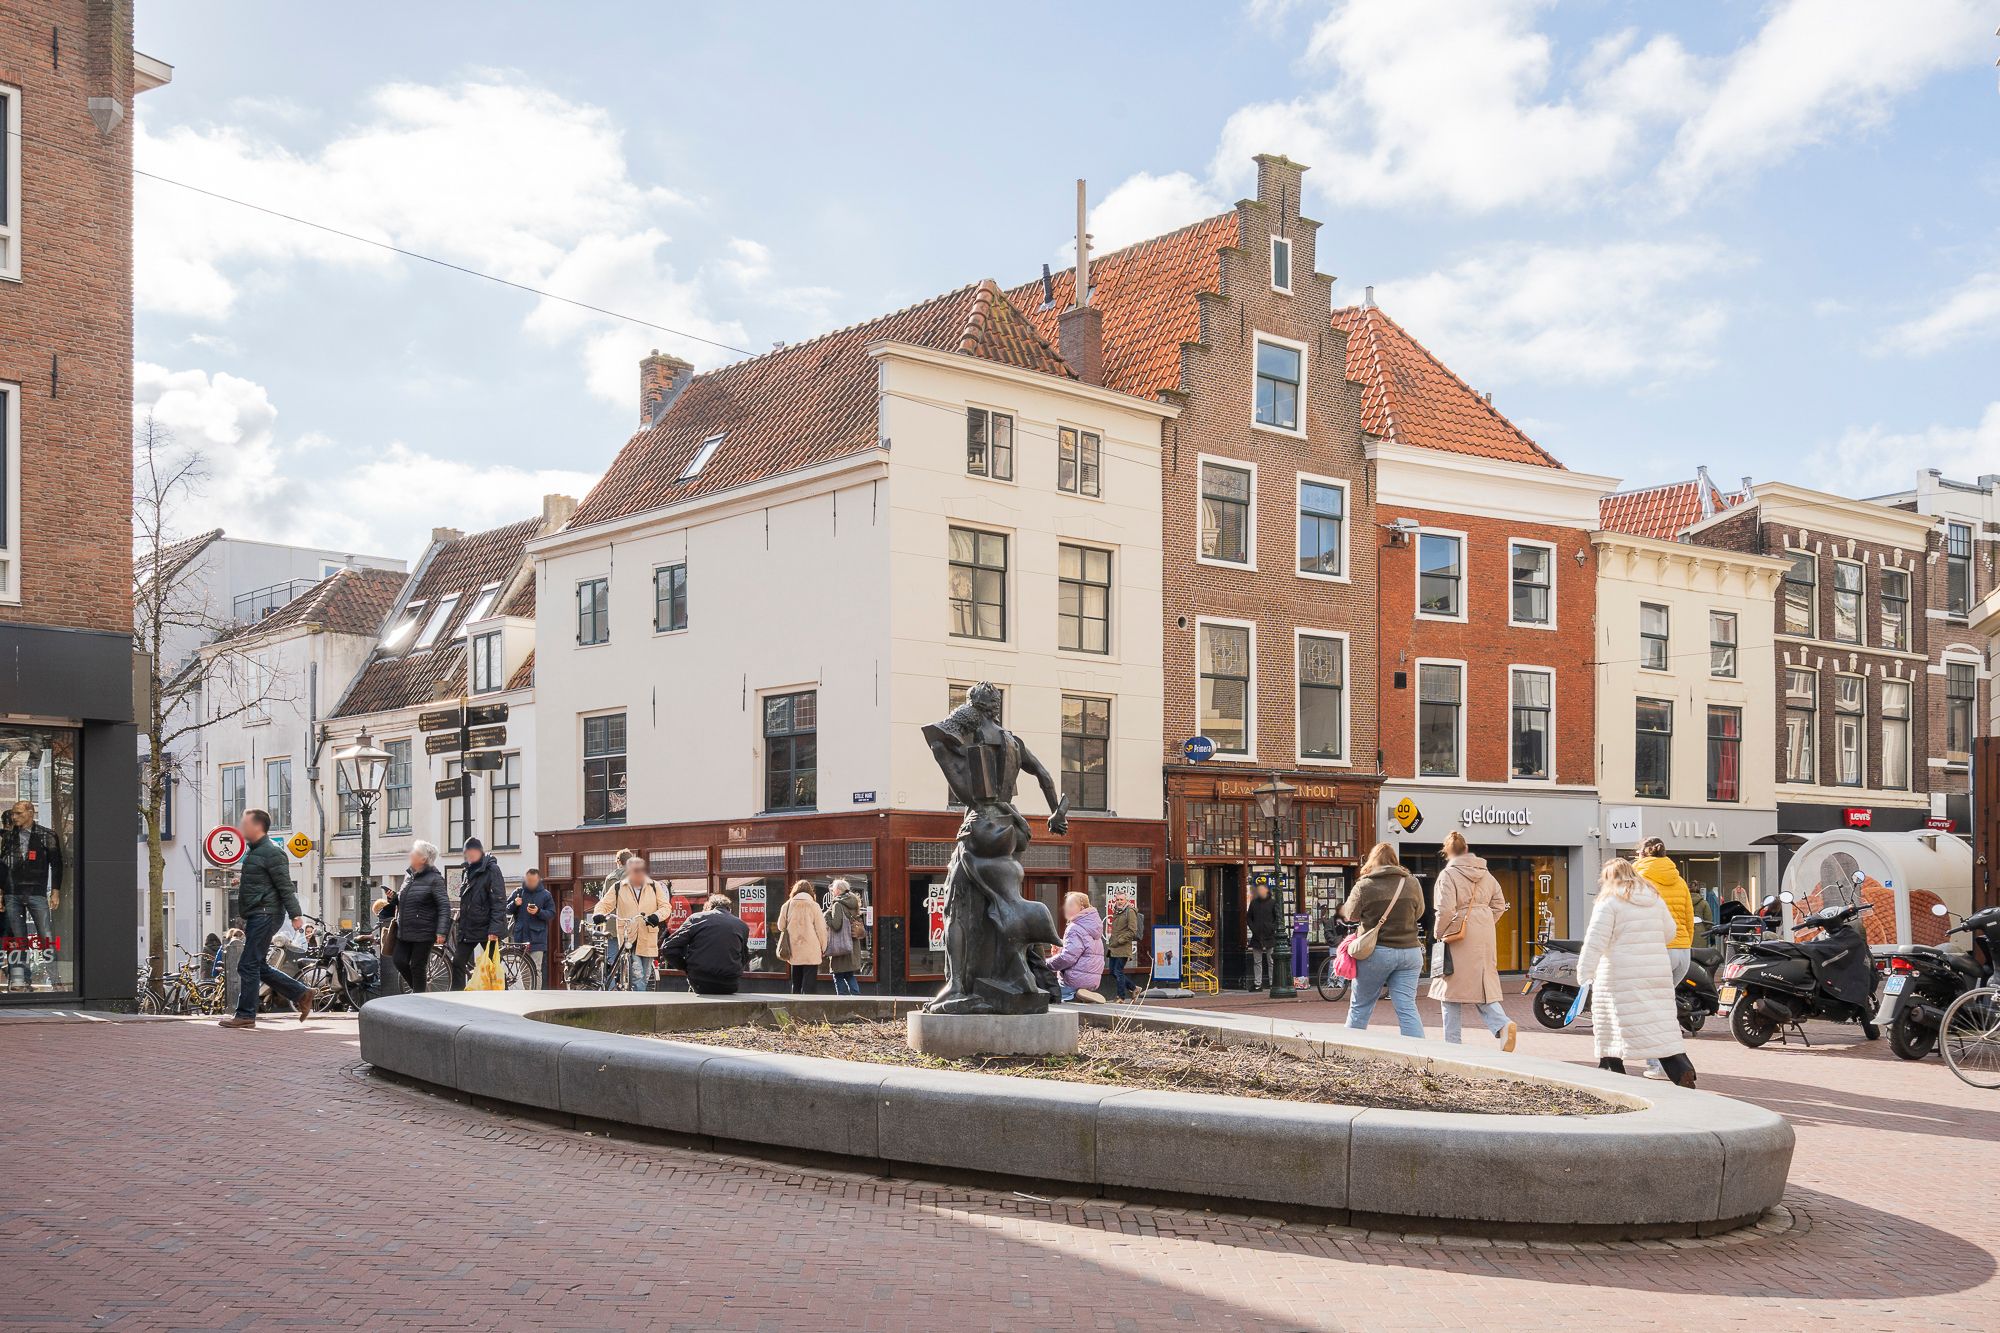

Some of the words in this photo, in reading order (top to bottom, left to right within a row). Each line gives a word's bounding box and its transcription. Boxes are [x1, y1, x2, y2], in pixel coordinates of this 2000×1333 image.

[1194, 744, 1211, 752] Primera
[1462, 804, 1533, 828] geldmaat
[1612, 821, 1637, 829] VILA
[1669, 820, 1719, 838] VILA
[740, 888, 766, 899] BASIS
[675, 900, 683, 910] TE
